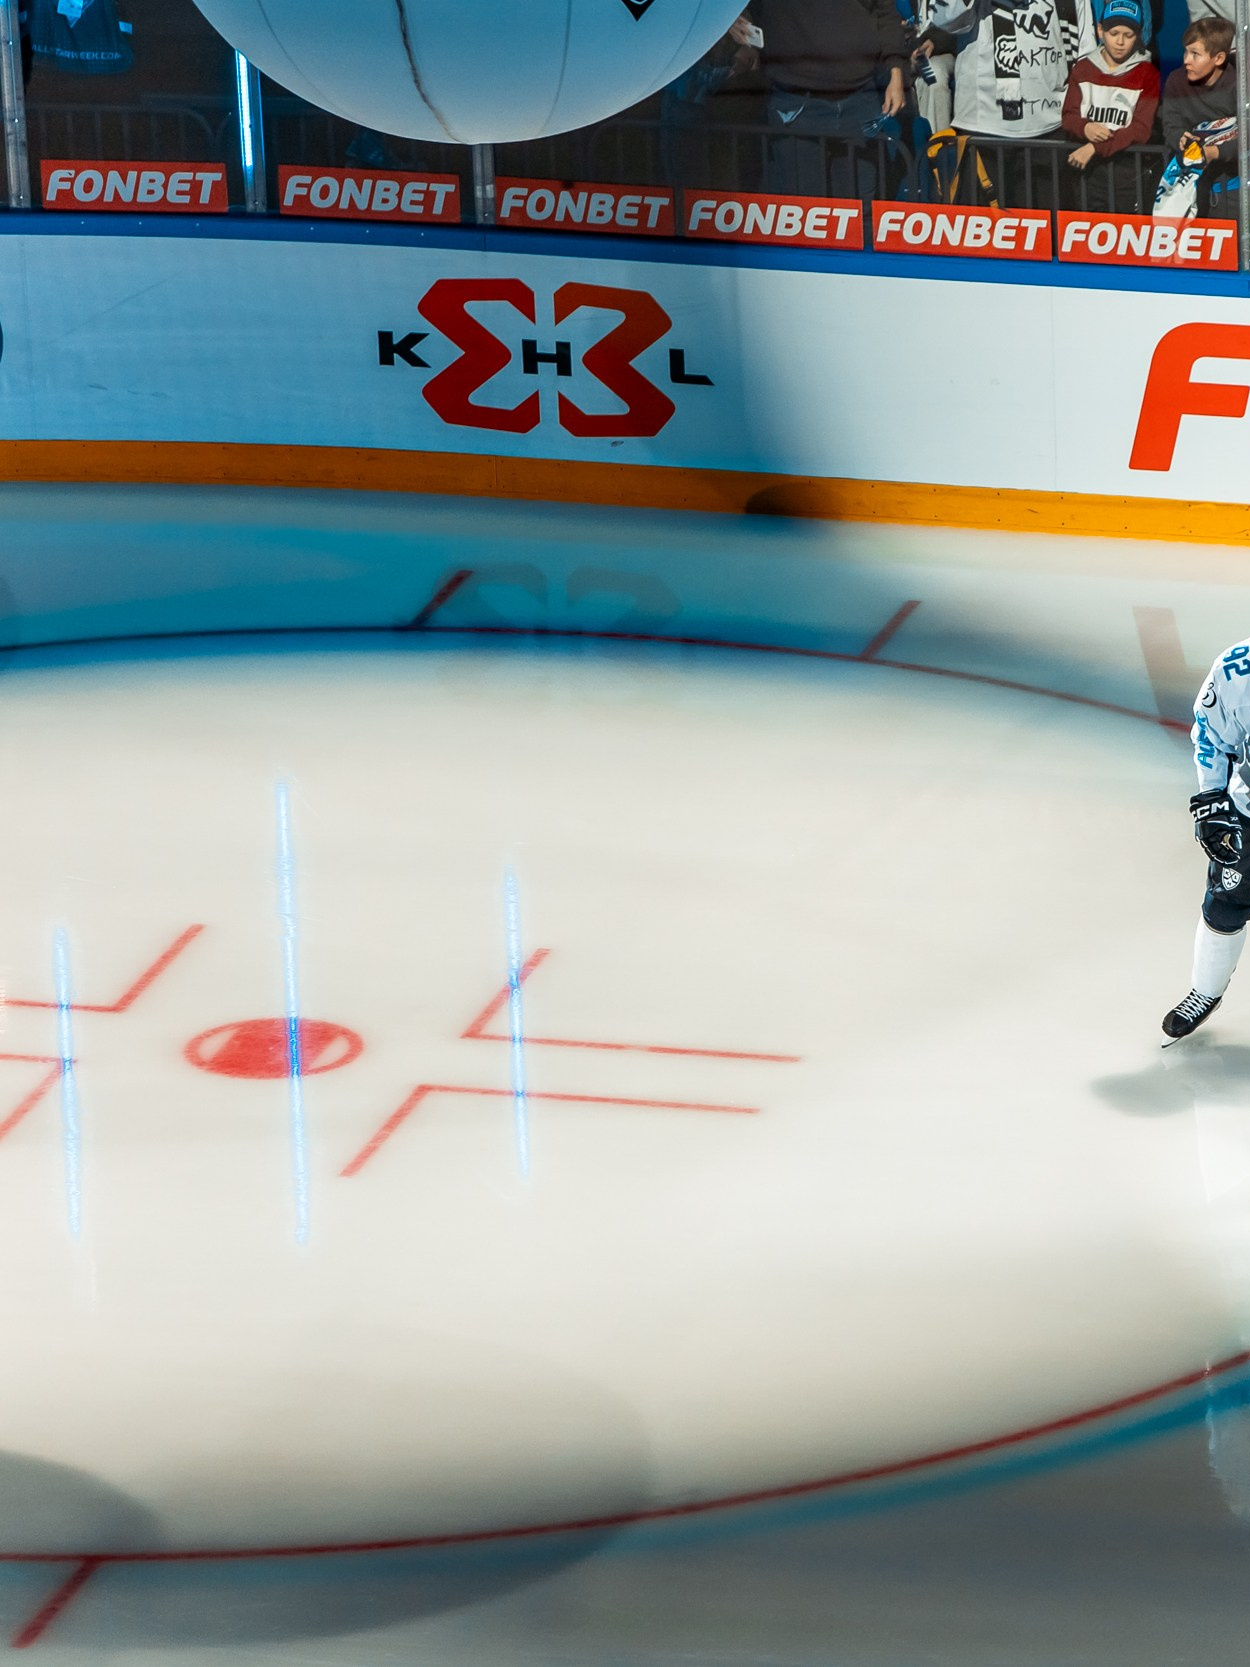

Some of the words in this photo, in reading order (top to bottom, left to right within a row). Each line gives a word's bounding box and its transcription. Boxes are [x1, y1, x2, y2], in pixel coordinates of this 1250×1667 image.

[46, 168, 223, 206] FONBET
[283, 174, 456, 216] FONBET
[500, 186, 670, 229] FONBET
[688, 198, 860, 241] FONBET
[875, 210, 1047, 252] FONBET
[1061, 220, 1234, 262] FONBET
